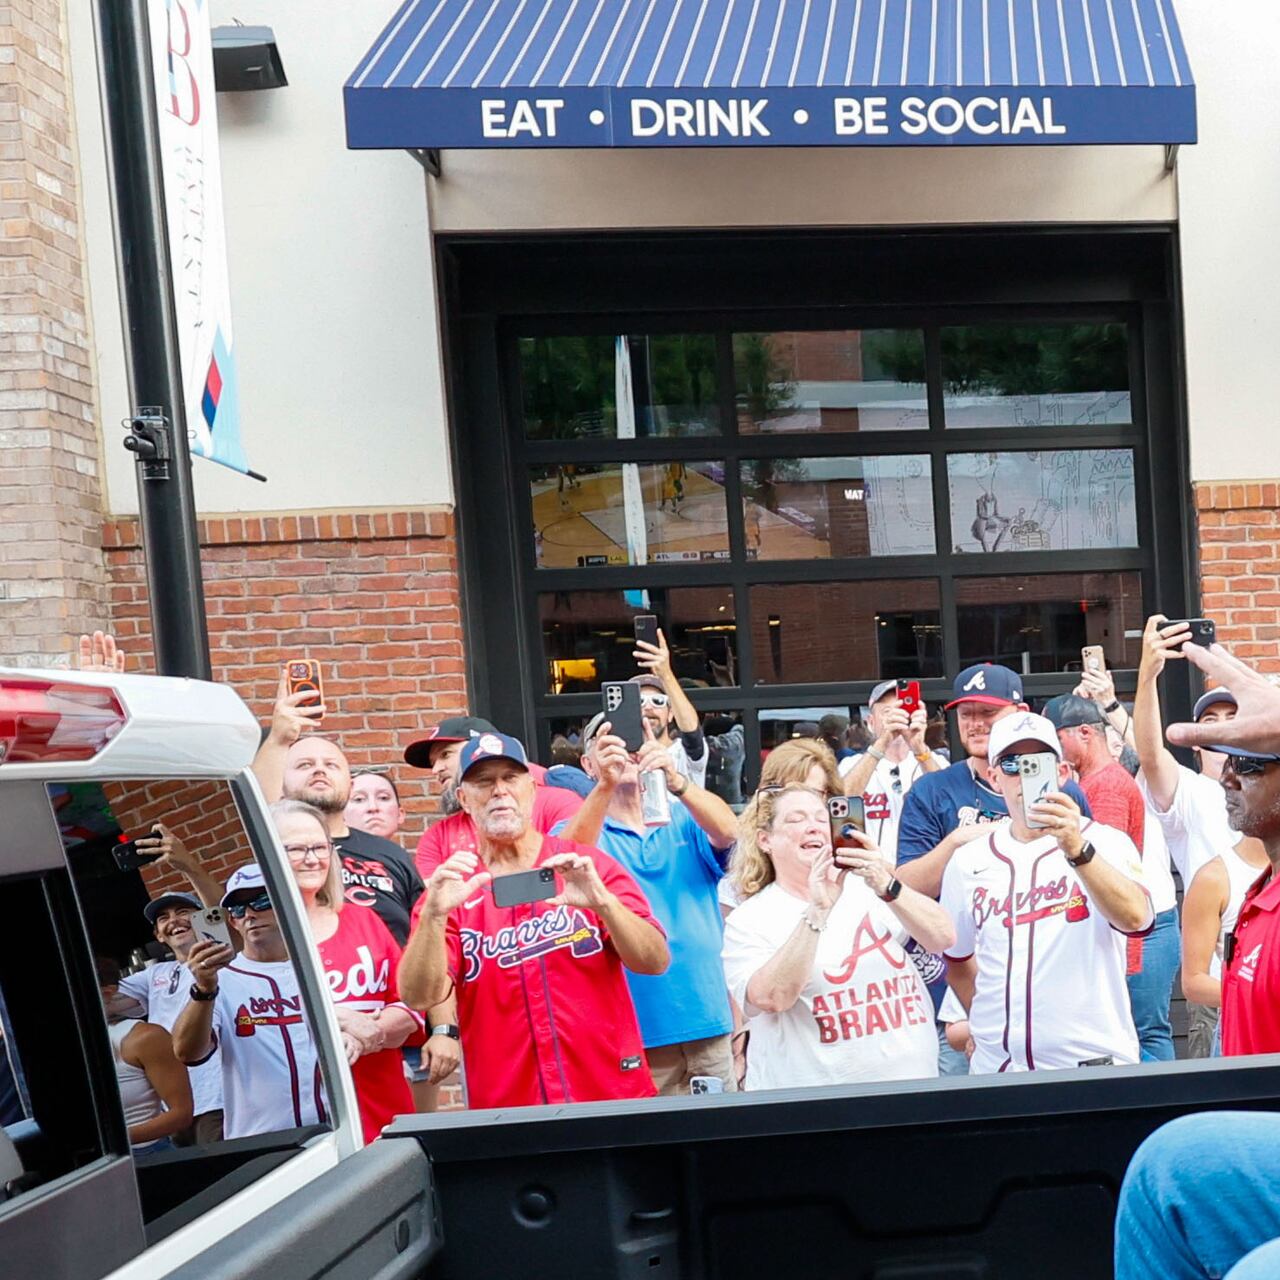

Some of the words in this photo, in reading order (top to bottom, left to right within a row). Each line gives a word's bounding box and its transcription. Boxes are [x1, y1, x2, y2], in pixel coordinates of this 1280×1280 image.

[481, 98, 564, 138] EAT
[630, 98, 771, 137] DRINK
[834, 97, 889, 135] BE
[900, 96, 1066, 135] SOCIAL
[970, 875, 1068, 930] Braves
[458, 904, 570, 983] Braves
[324, 945, 389, 1001] eds
